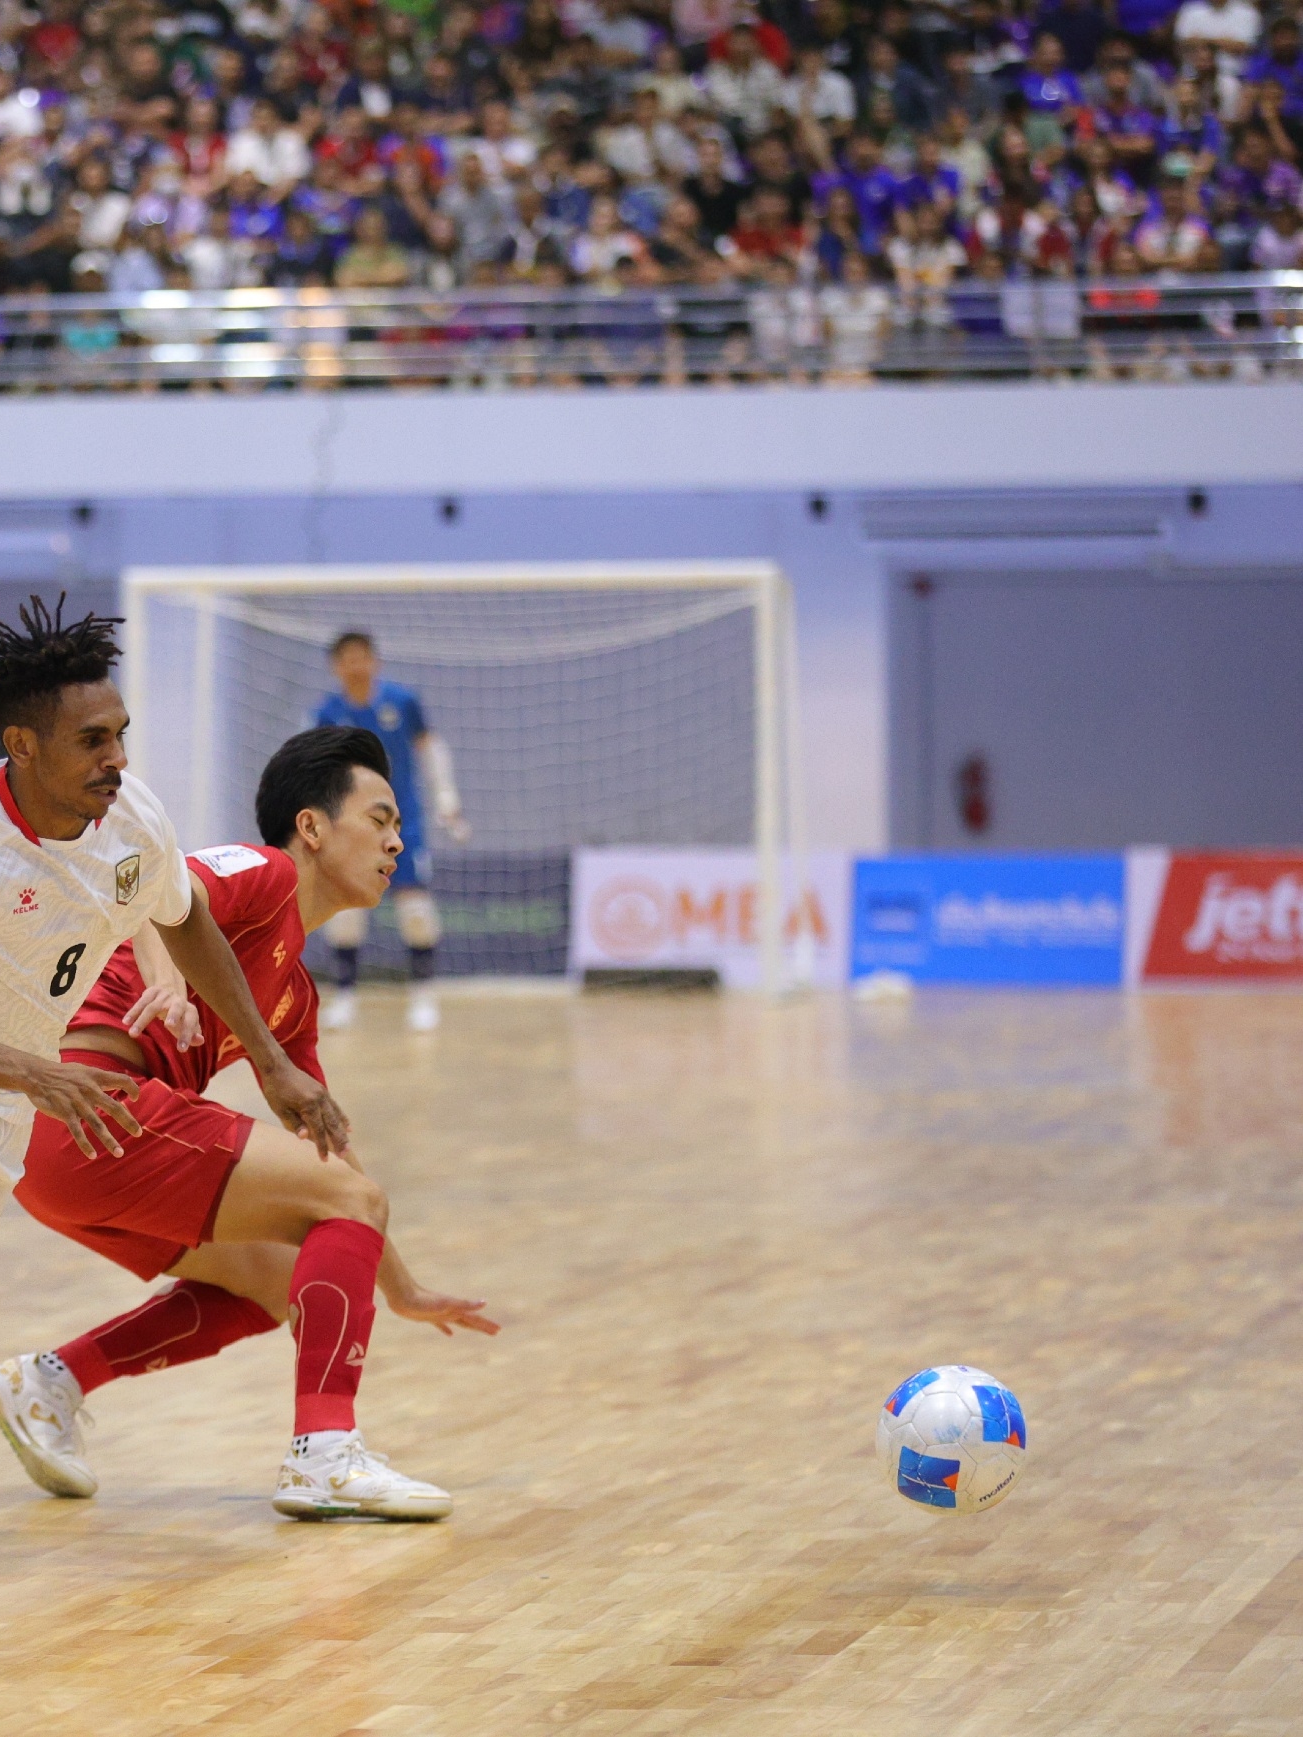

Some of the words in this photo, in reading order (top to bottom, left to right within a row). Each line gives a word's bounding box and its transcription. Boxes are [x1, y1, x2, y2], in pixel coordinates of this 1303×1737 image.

[13, 903, 39, 914] KELME
[49, 943, 86, 997] 8
[979, 1471, 1015, 1502] molten
